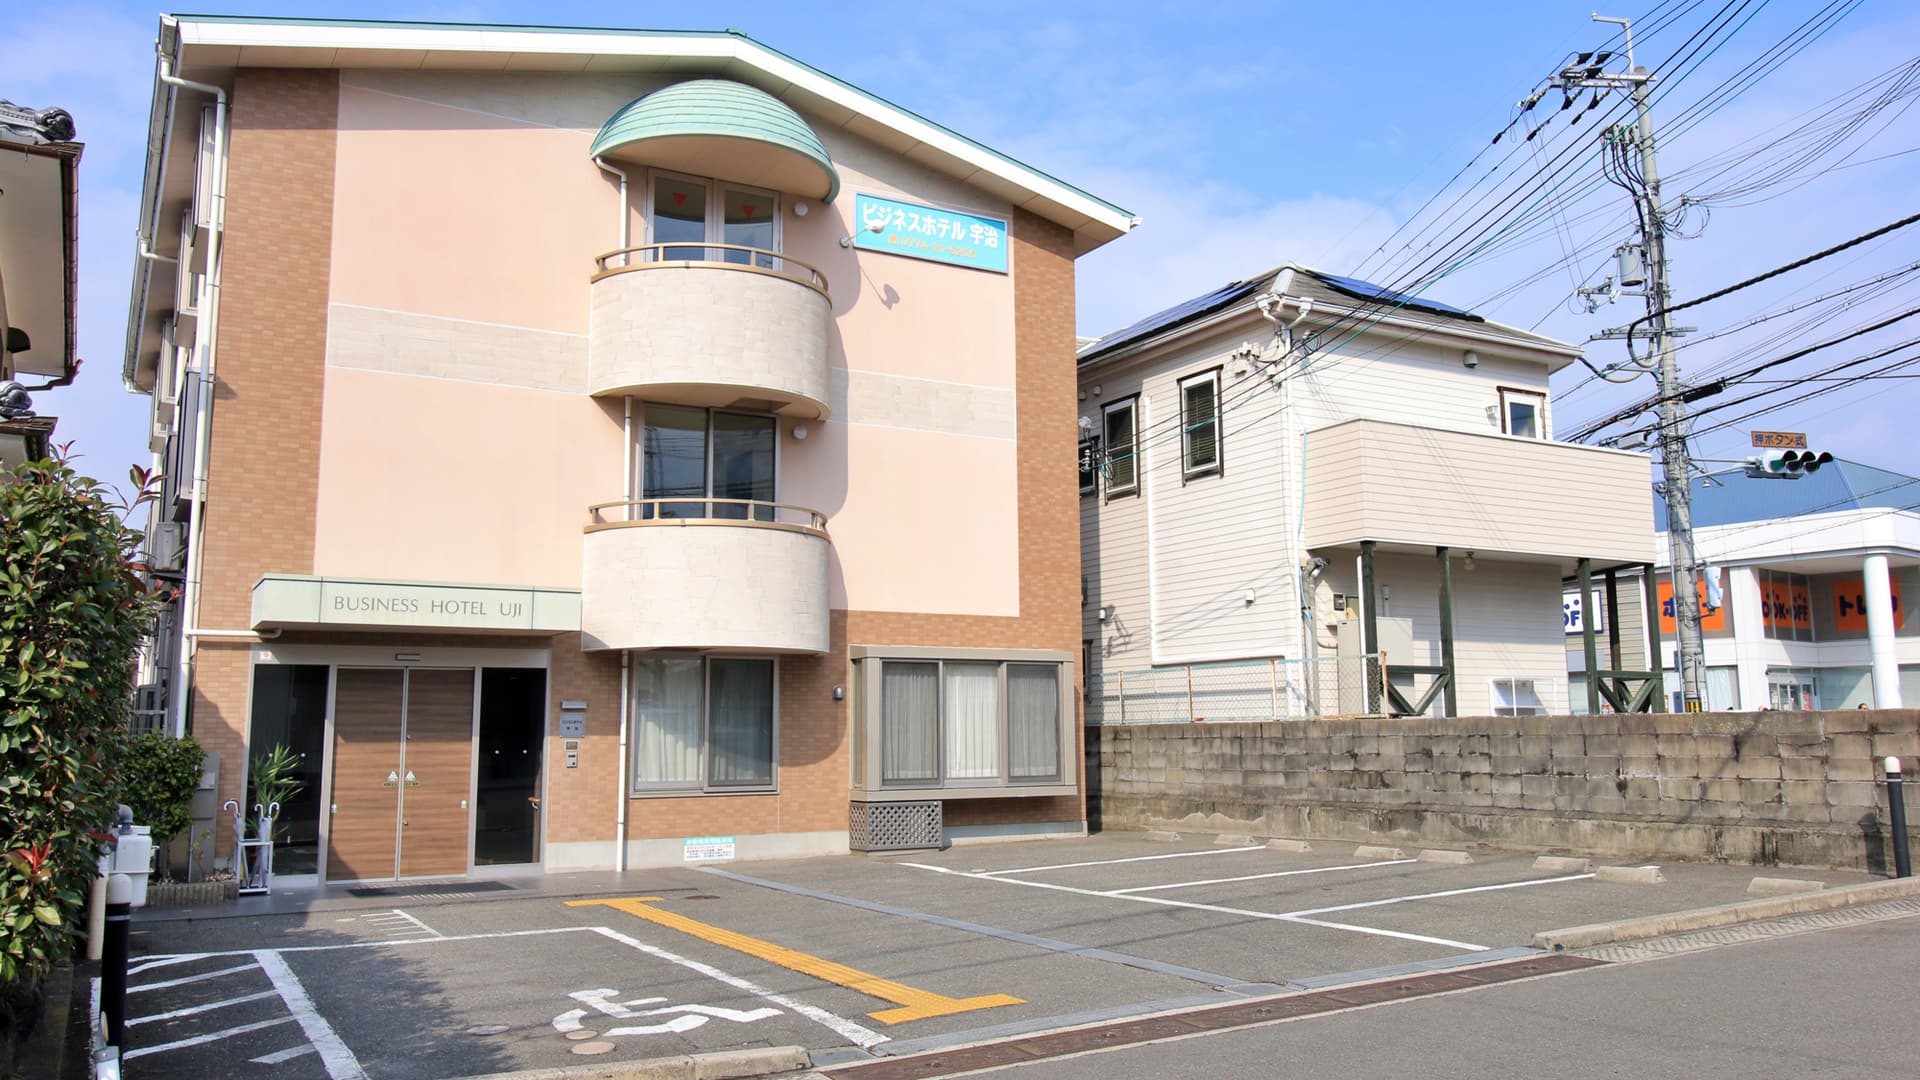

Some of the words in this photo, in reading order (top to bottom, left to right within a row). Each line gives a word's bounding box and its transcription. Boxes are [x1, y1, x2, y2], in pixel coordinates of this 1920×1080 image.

[863, 203, 966, 241] ビジネスホテル
[970, 224, 999, 248] 宇治
[1755, 433, 1805, 446] 押ボタン式
[333, 595, 419, 613] BUSINESS
[431, 599, 488, 616] HOTEL
[499, 602, 522, 617] UJI
